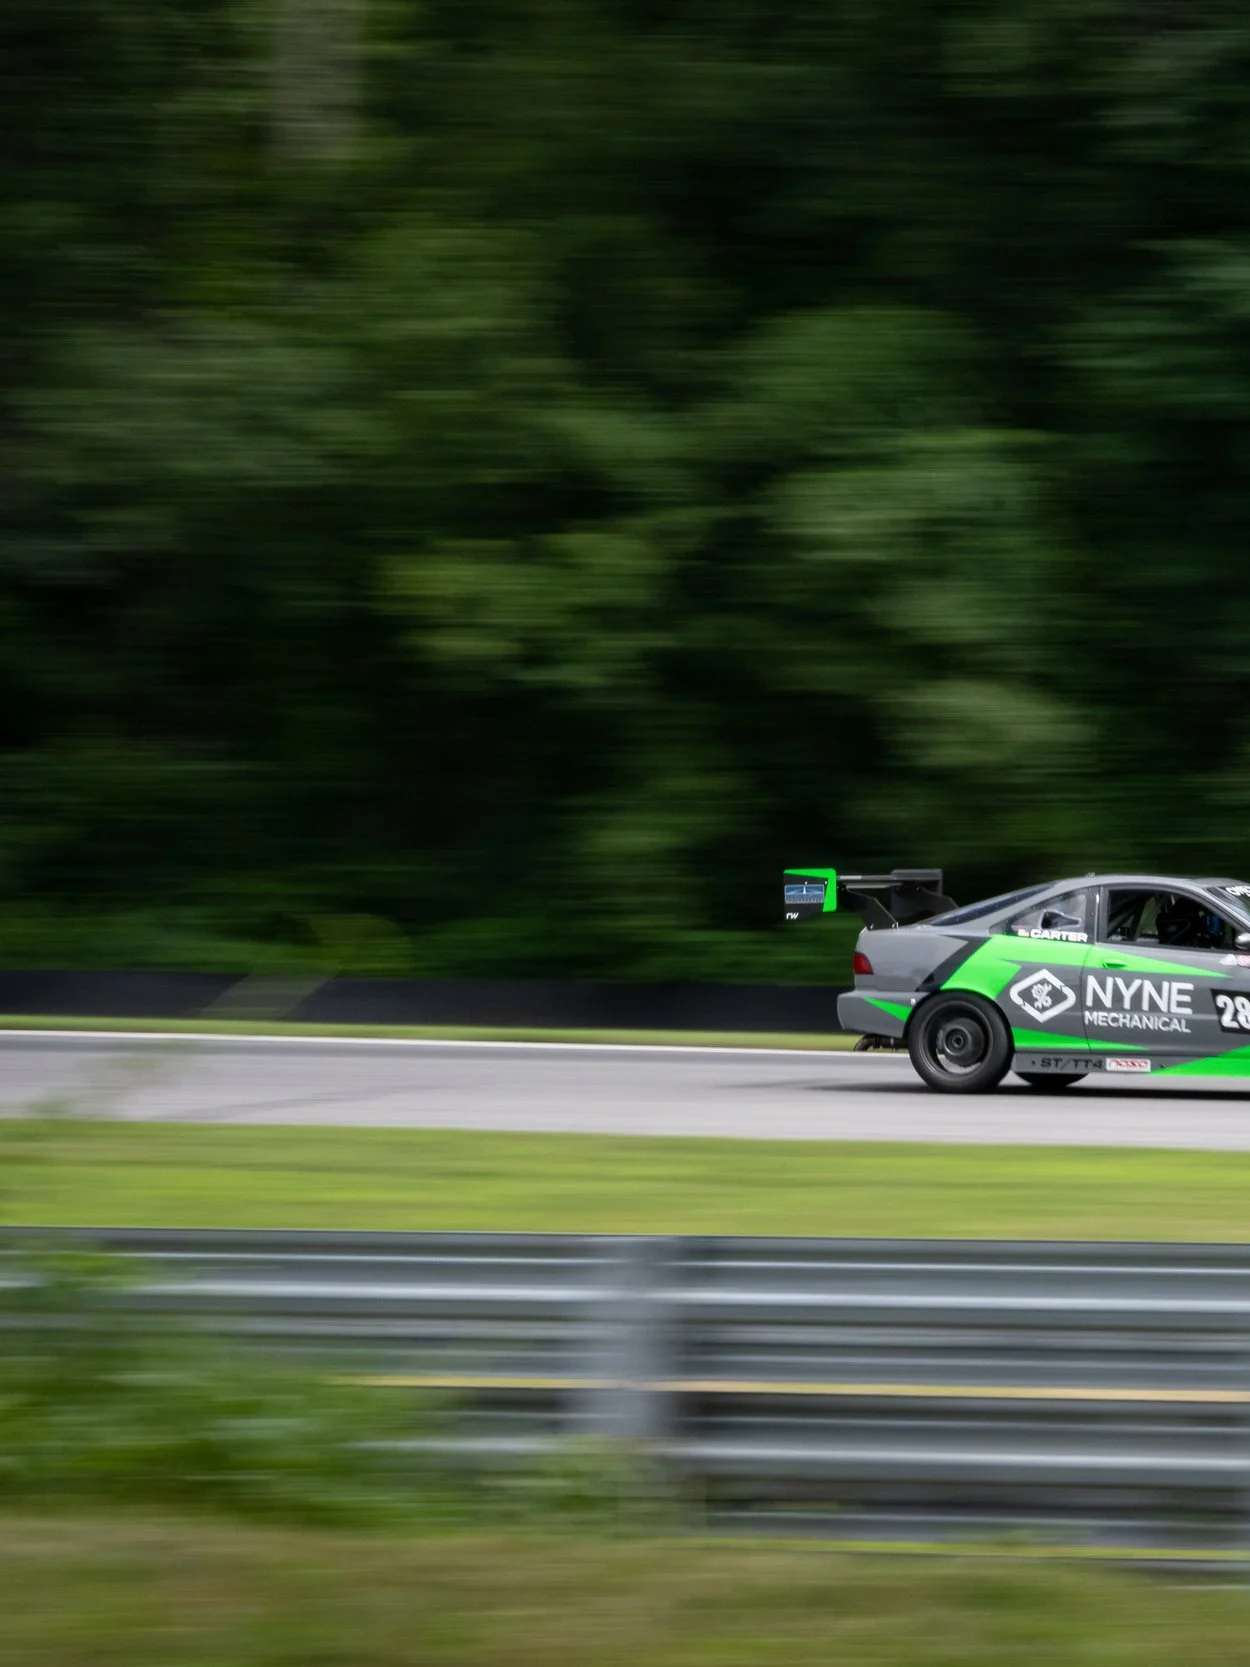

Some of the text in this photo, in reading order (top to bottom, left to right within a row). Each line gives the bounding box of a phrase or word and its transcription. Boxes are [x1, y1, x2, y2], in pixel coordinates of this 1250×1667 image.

[1030, 928, 1088, 943] CARTER
[1085, 975, 1195, 1015] NYNE
[1084, 1010, 1192, 1033] MECHANICAL
